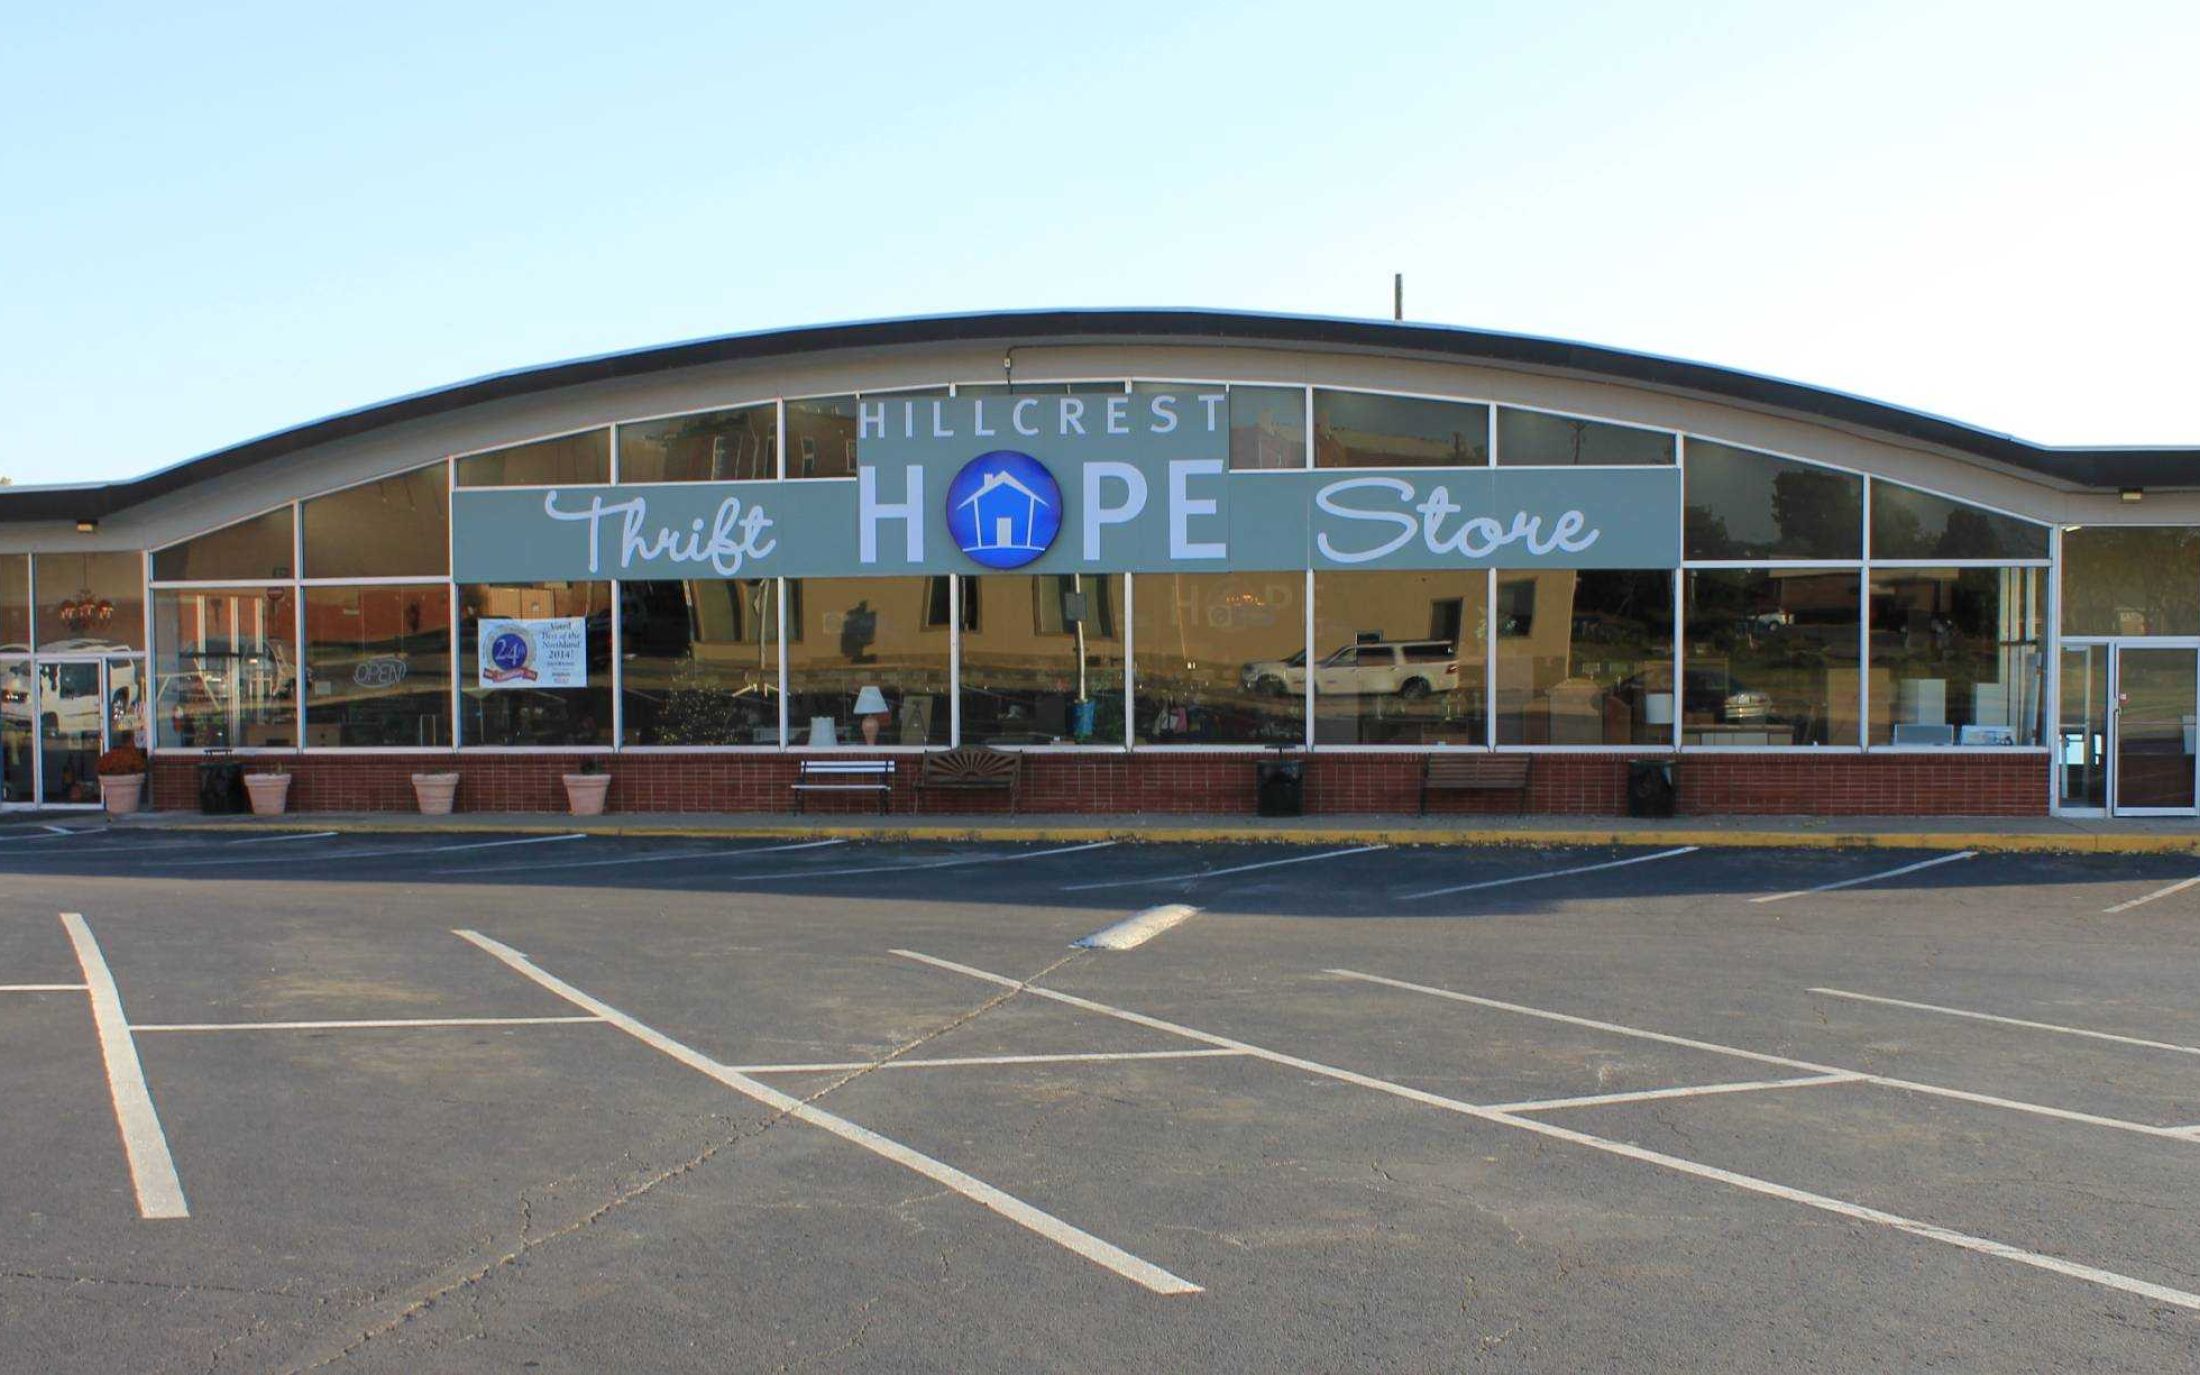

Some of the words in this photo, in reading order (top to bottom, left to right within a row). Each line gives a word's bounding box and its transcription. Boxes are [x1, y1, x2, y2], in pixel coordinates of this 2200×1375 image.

[859, 394, 1226, 438] HILLCREST
[545, 488, 777, 577] Thrift
[1315, 476, 1601, 563] Store
[355, 662, 402, 682] OPEN
